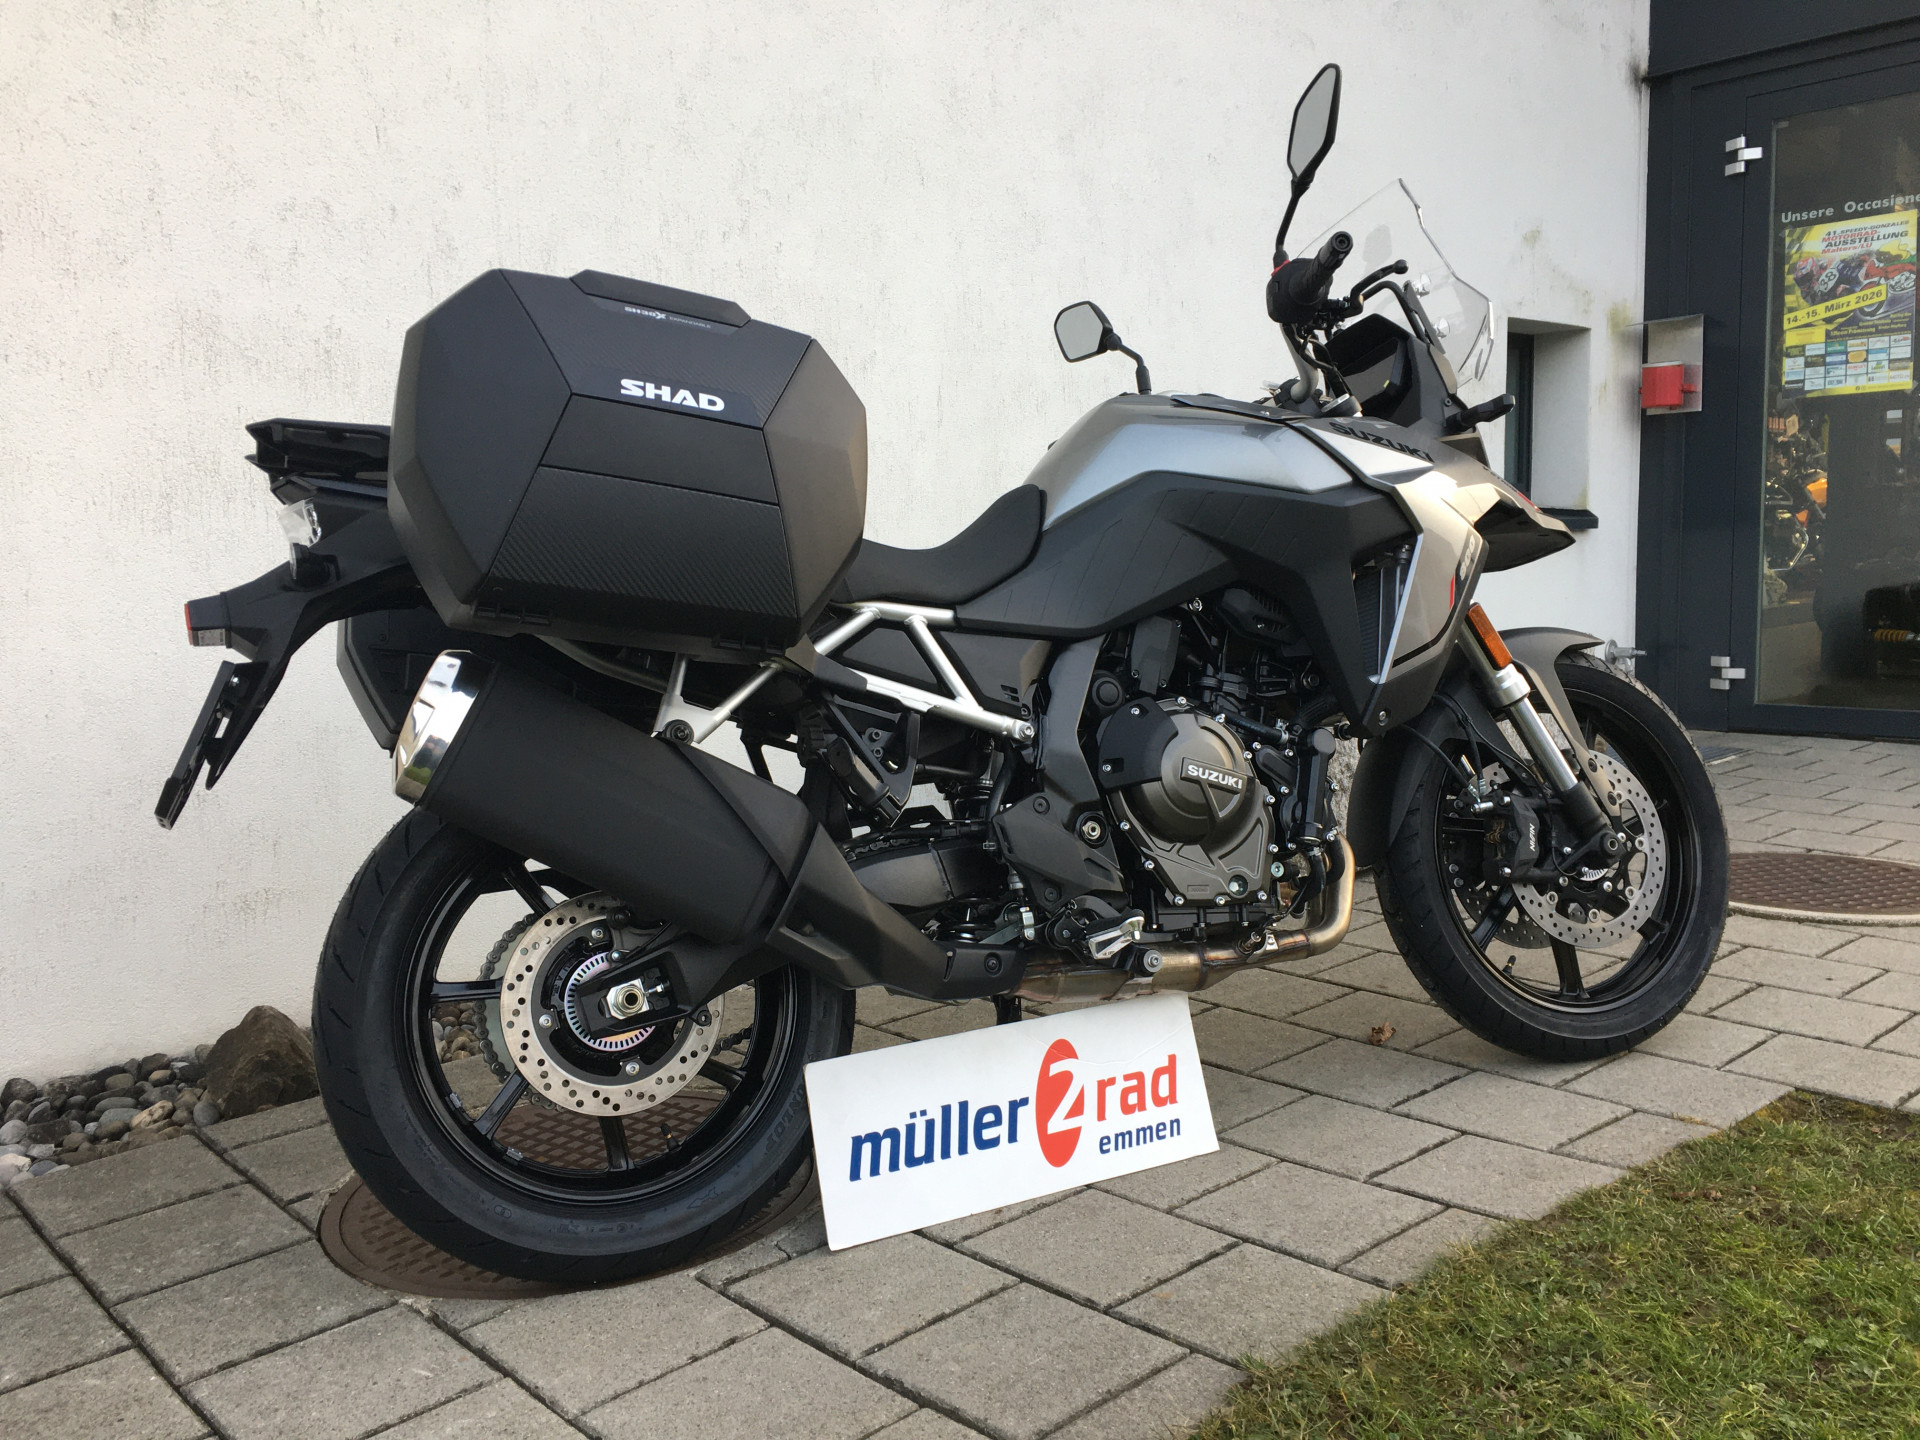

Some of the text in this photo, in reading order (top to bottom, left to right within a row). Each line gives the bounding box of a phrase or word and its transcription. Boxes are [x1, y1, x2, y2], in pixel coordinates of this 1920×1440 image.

[1781, 207, 1835, 223] Unsere
[1825, 231, 1909, 248] AUSSTELLUNG
[1824, 300, 1851, 314] März
[1855, 289, 1883, 305] 2026
[620, 378, 725, 412] SHAD
[1328, 421, 1435, 463] SUZUKI
[1187, 764, 1243, 790] SUZUKI
[849, 1096, 1030, 1182] müller
[1098, 1117, 1182, 1155] emmen
